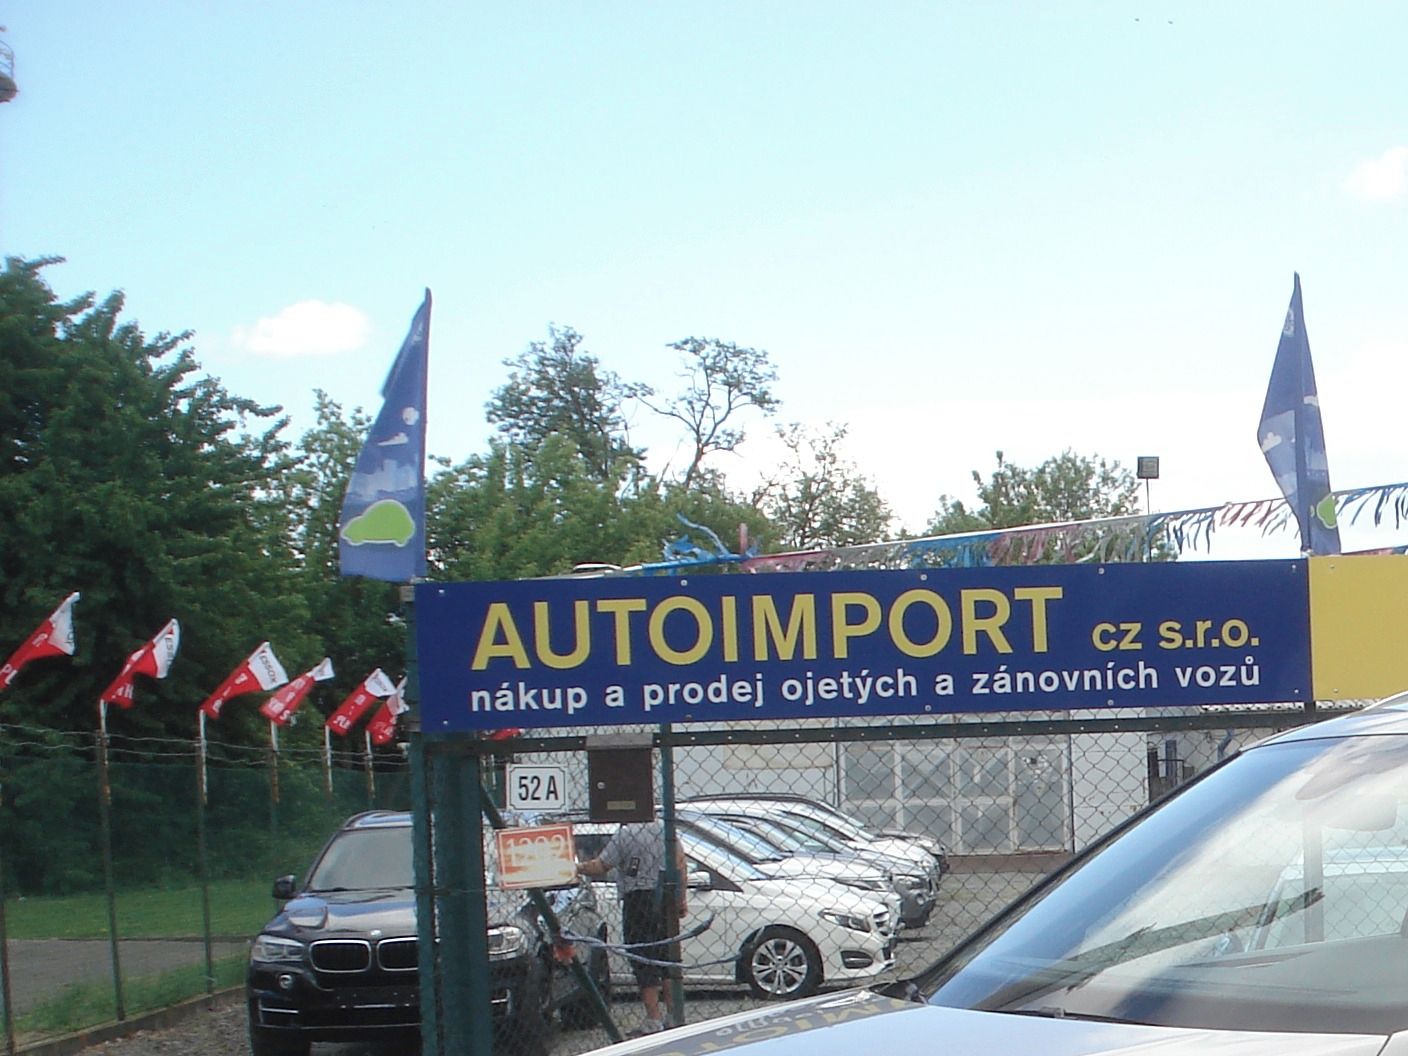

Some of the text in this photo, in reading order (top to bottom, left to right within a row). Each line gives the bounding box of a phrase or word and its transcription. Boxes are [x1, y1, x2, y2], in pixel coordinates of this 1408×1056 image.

[470, 586, 1260, 671] AUTOIMPORT cz s.r.o.
[471, 655, 1260, 714] nákup a prodej ojetých a zánovních vozů
